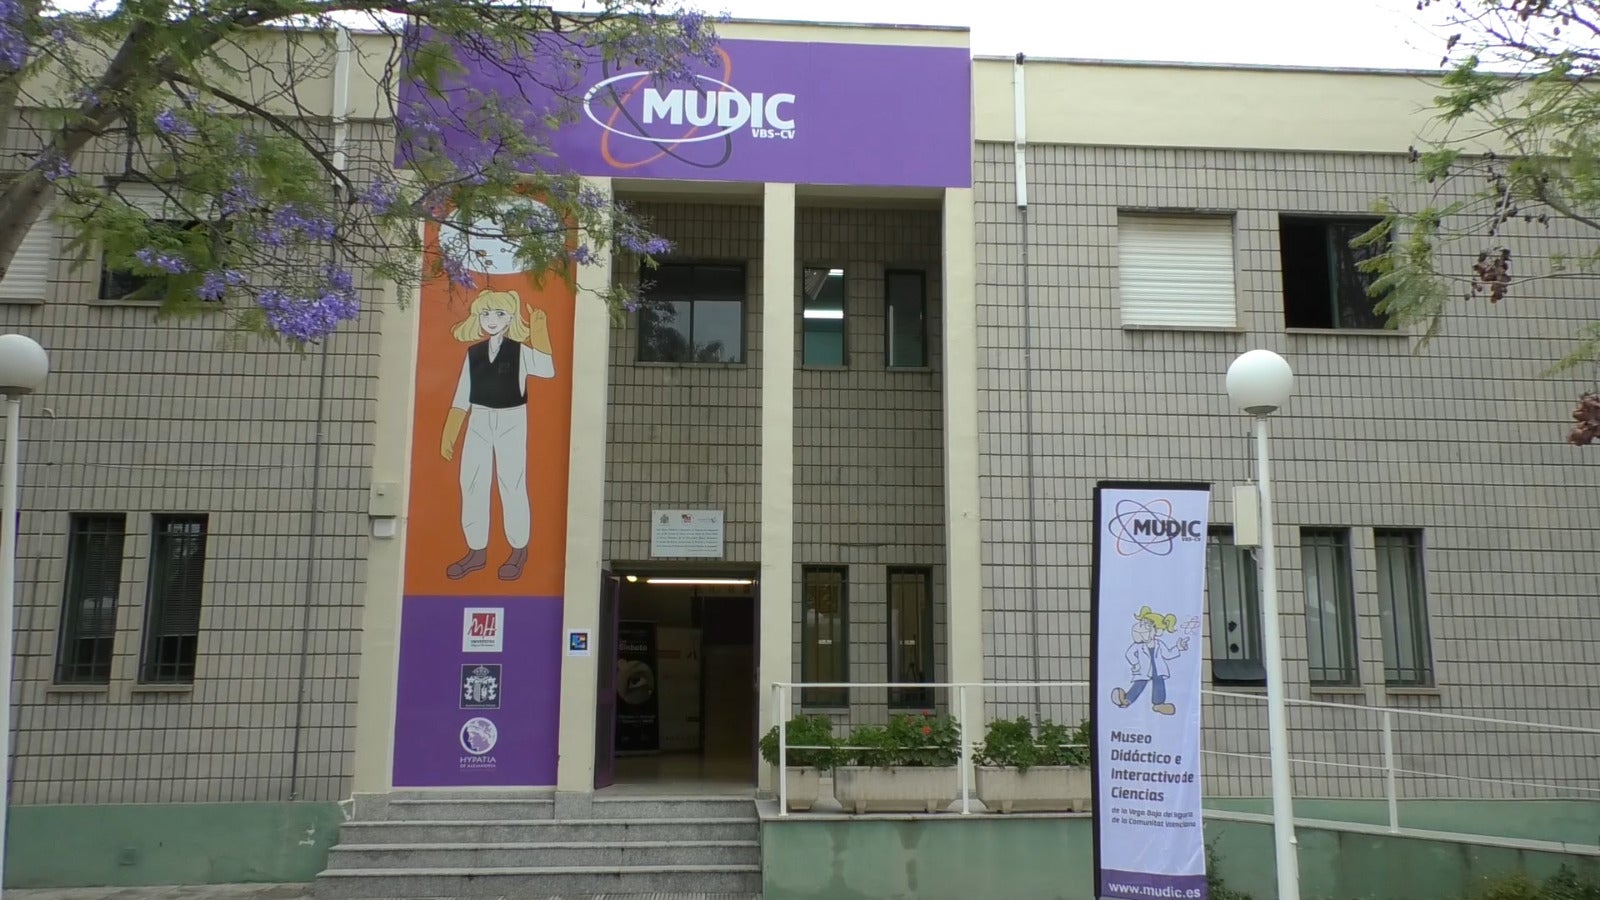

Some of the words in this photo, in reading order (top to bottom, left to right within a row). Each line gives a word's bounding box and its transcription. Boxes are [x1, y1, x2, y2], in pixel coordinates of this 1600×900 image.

[643, 88, 795, 130] MUDIC
[751, 128, 795, 139] VBS-CV
[1133, 519, 1201, 537] MUDIC
[1110, 730, 1152, 744] Museo
[459, 756, 497, 764] HYPATIA
[1110, 748, 1171, 764] Didáctico
[1175, 755, 1182, 764] e
[1111, 768, 1181, 783] Interactivo
[1182, 771, 1194, 783] de
[1111, 786, 1164, 801] Ciencias
[1129, 808, 1146, 817] Vega
[1147, 809, 1162, 818] Baja
[1108, 882, 1201, 898] www.mudic.es
